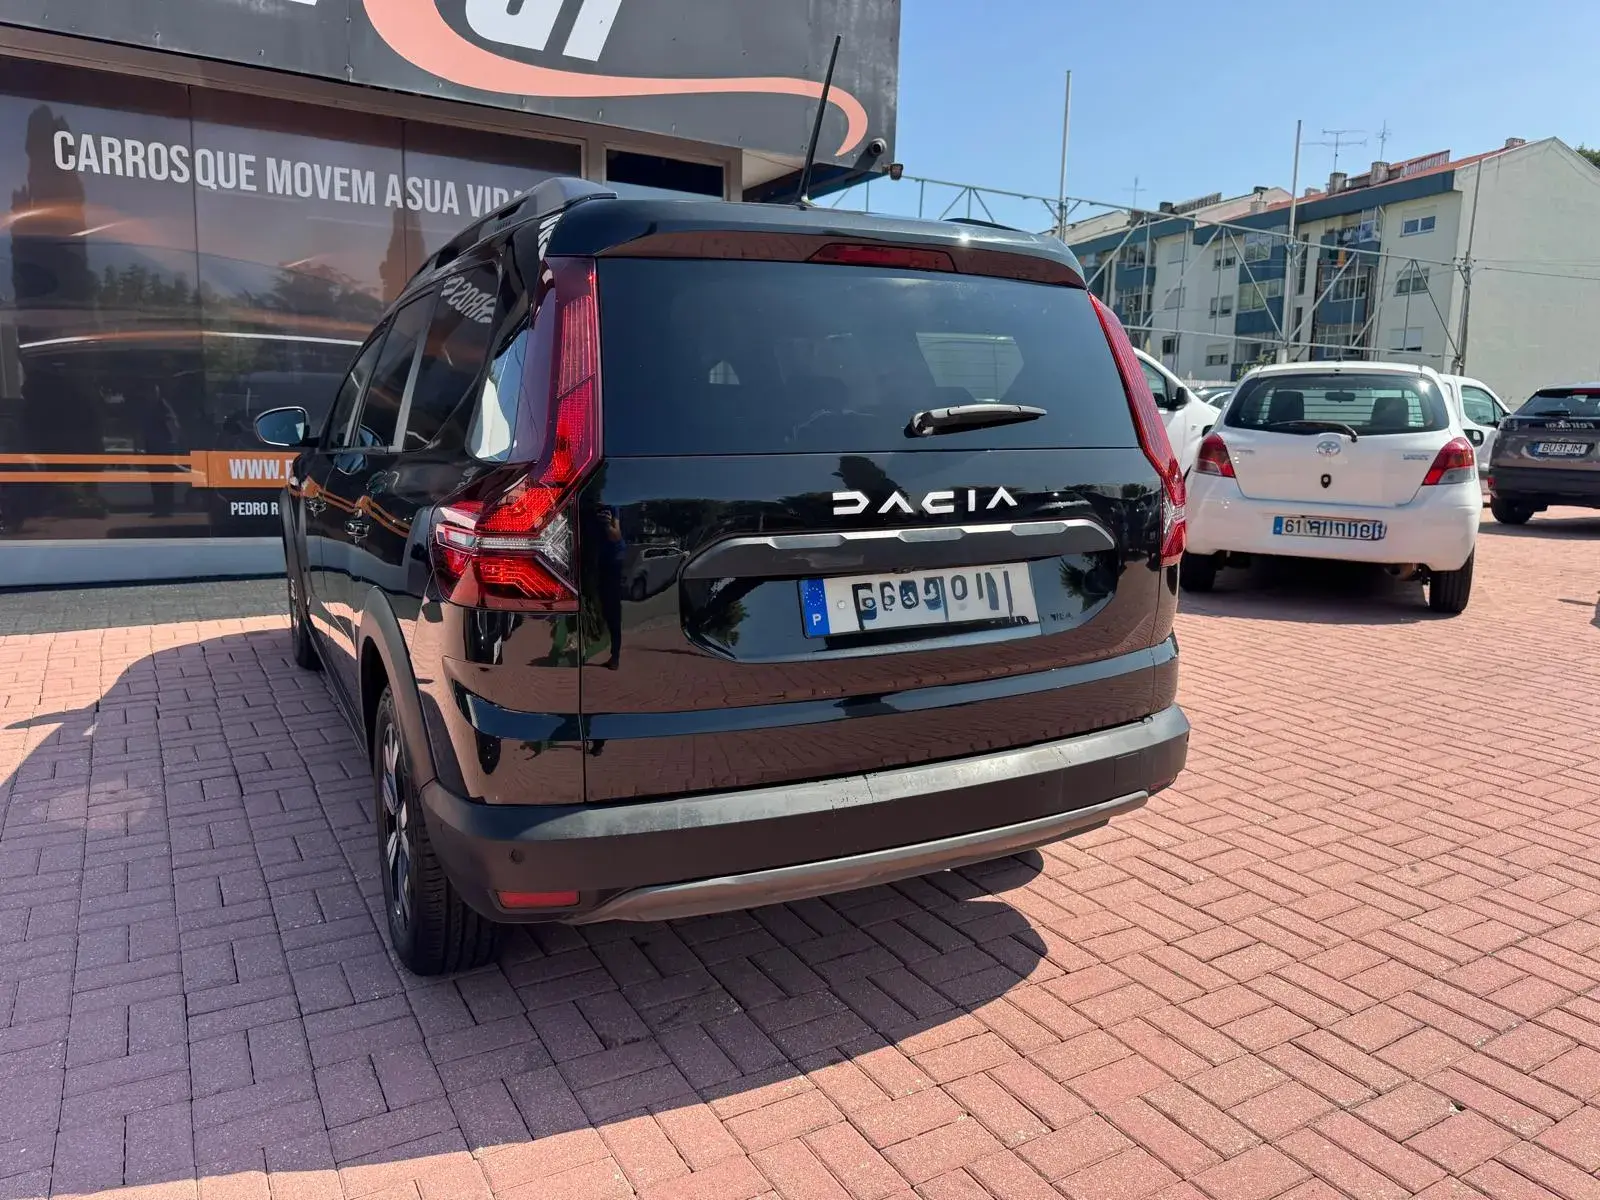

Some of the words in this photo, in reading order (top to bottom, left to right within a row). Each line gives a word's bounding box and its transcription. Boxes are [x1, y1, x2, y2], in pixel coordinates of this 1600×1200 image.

[54, 130, 190, 184] CARROS
[195, 148, 257, 191] QUE
[266, 157, 376, 206] MOVEM
[384, 173, 404, 209] A
[405, 176, 460, 215] SUA
[231, 502, 268, 515] PEDRO
[831, 486, 1018, 515] DACIA
[812, 613, 822, 626] P
